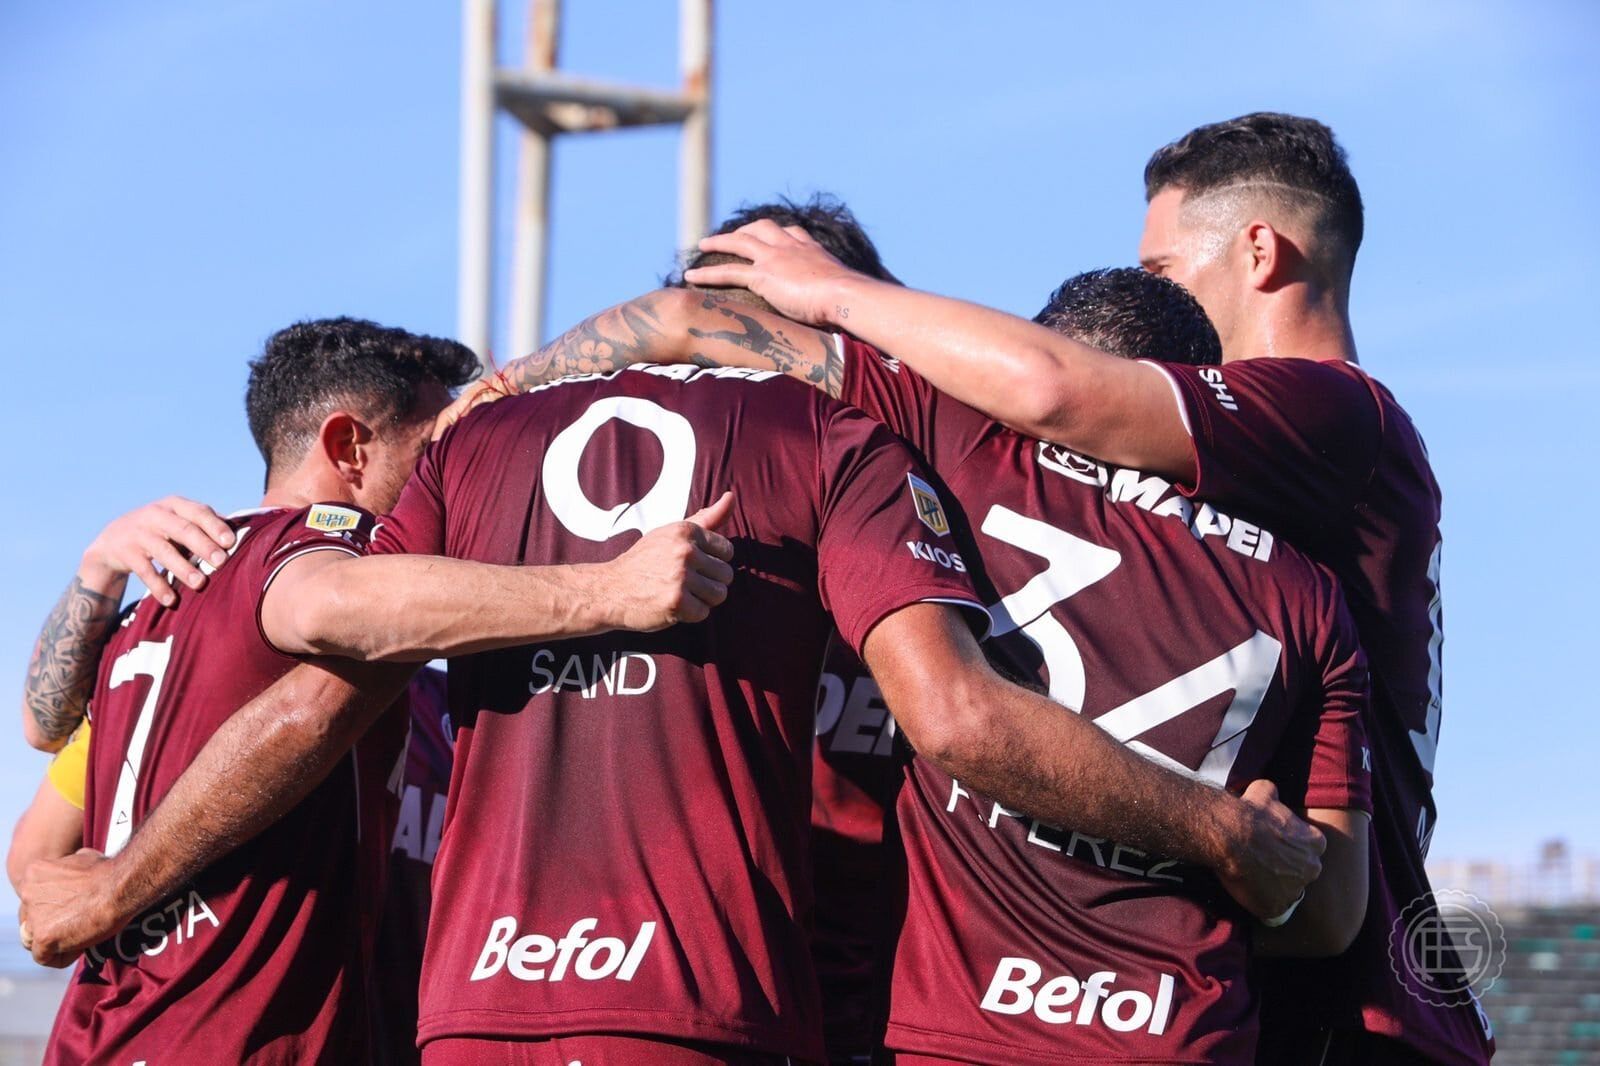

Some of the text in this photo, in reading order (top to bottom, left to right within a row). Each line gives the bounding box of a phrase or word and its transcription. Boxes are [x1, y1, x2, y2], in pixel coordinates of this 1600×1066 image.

[542, 396, 697, 542] 9
[1110, 468, 1274, 563] MAPEI
[906, 541, 967, 573] KIOS
[528, 648, 657, 701] SAND
[108, 634, 174, 858] 7
[469, 915, 657, 982] Befol
[979, 956, 1176, 1037] Befol
